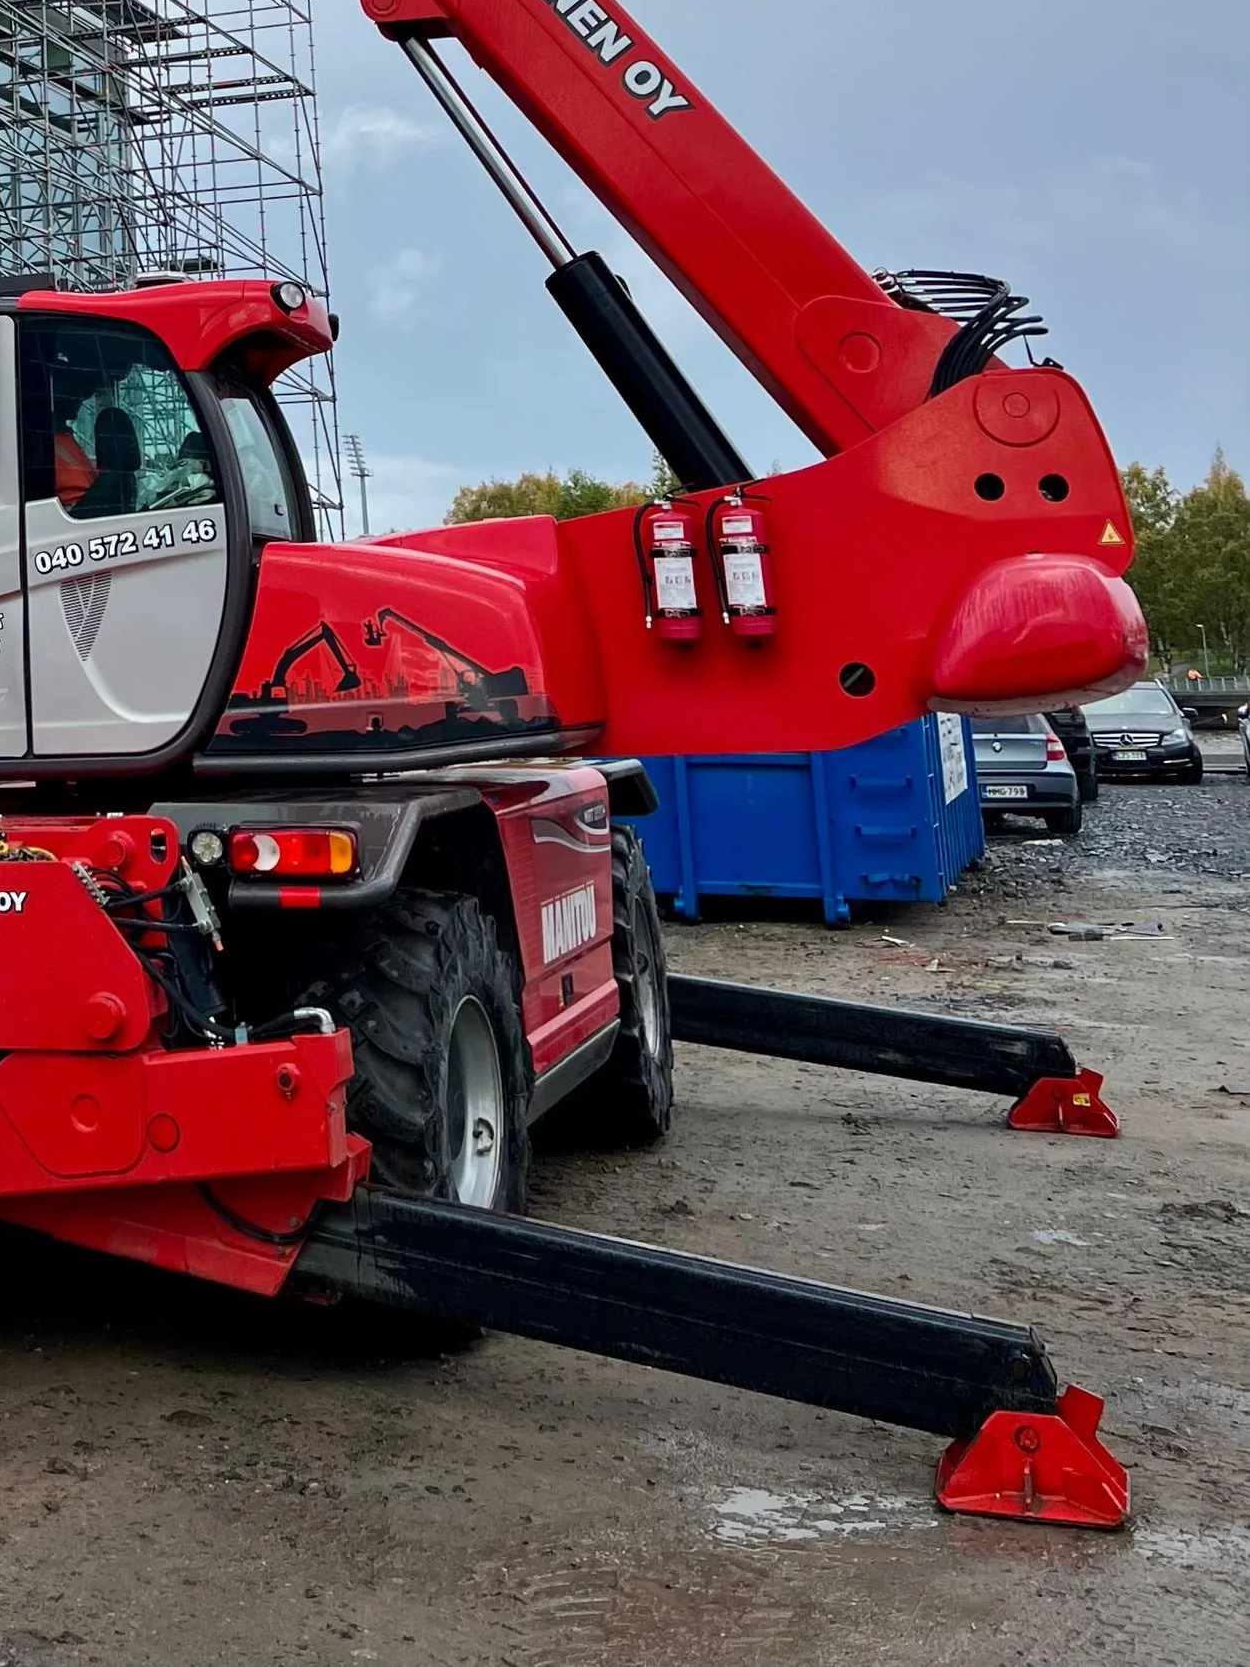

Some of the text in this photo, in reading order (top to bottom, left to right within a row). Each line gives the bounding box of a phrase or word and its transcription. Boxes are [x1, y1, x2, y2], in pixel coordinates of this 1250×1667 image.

[623, 60, 692, 118] OY
[35, 519, 217, 574] 040 572 41 46
[541, 884, 597, 965] MANITOU
